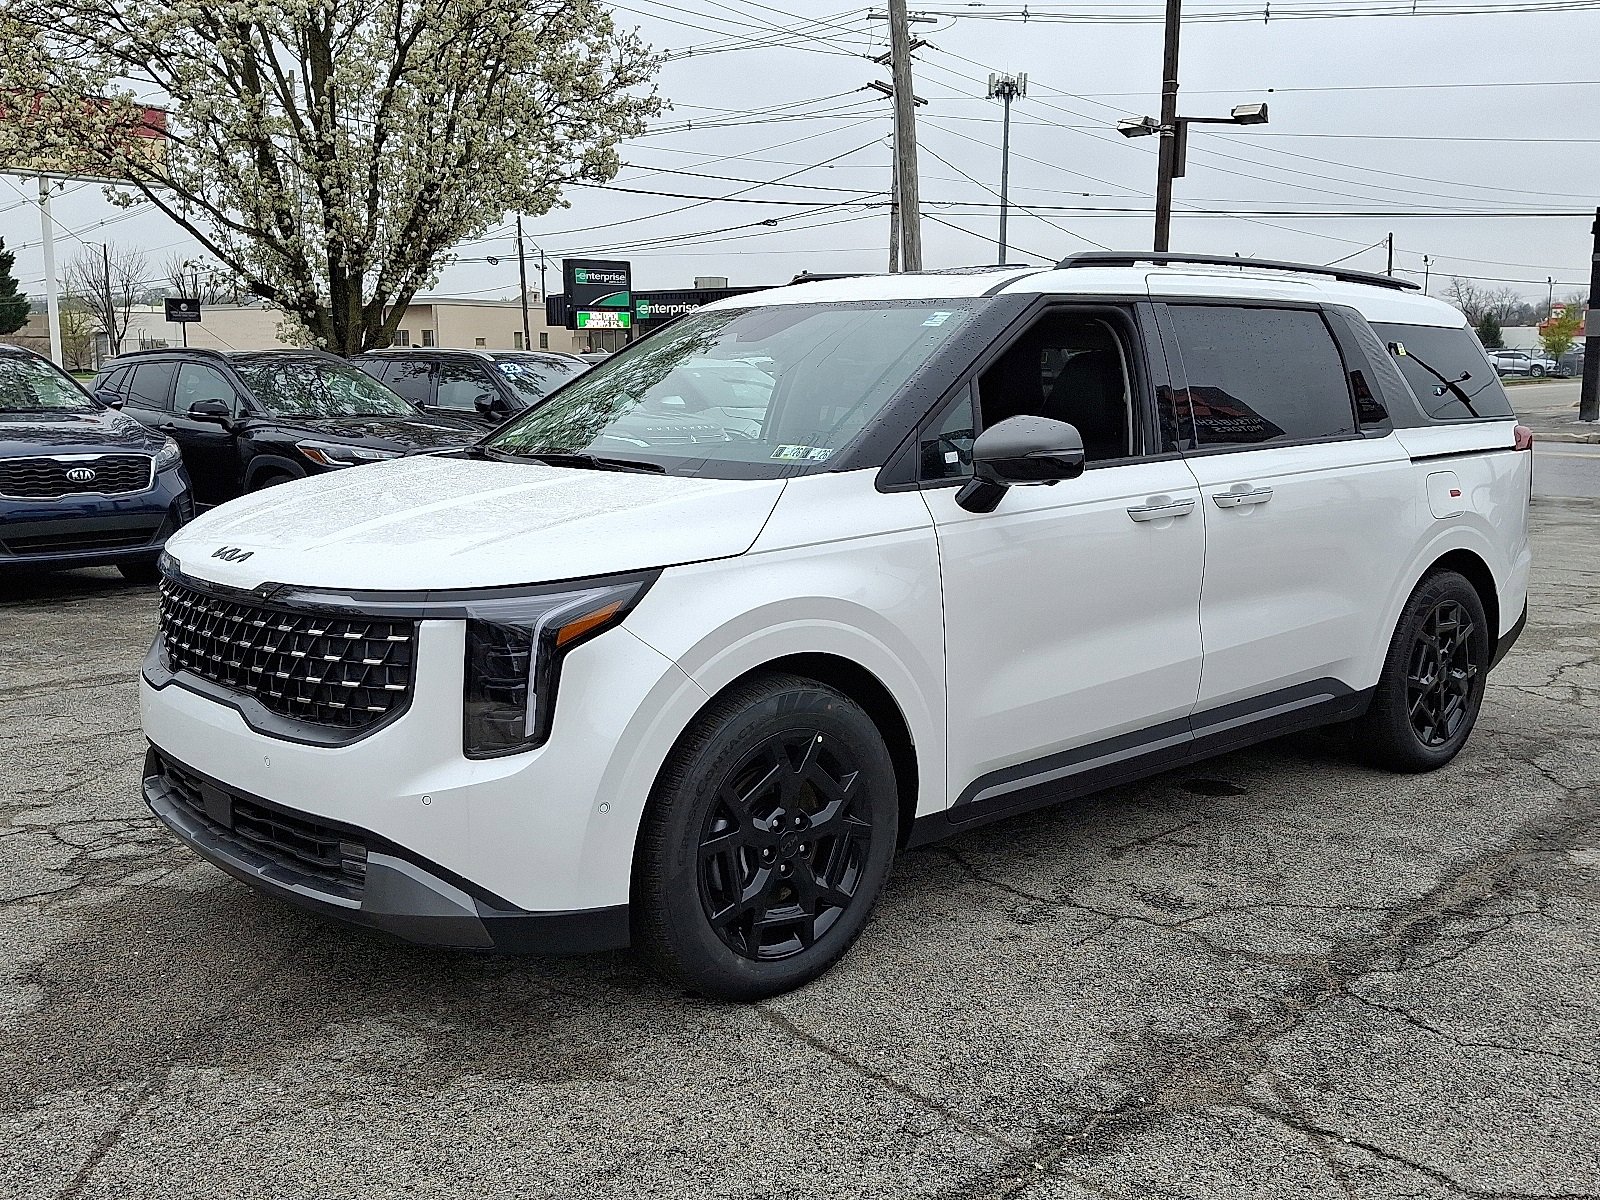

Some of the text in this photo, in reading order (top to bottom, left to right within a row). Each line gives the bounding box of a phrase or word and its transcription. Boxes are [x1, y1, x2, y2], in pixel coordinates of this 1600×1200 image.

[579, 272, 625, 283] enterprise
[639, 302, 699, 316] enterprise
[504, 364, 518, 372] 22
[71, 470, 92, 480] KIA
[211, 545, 254, 563] KIA
